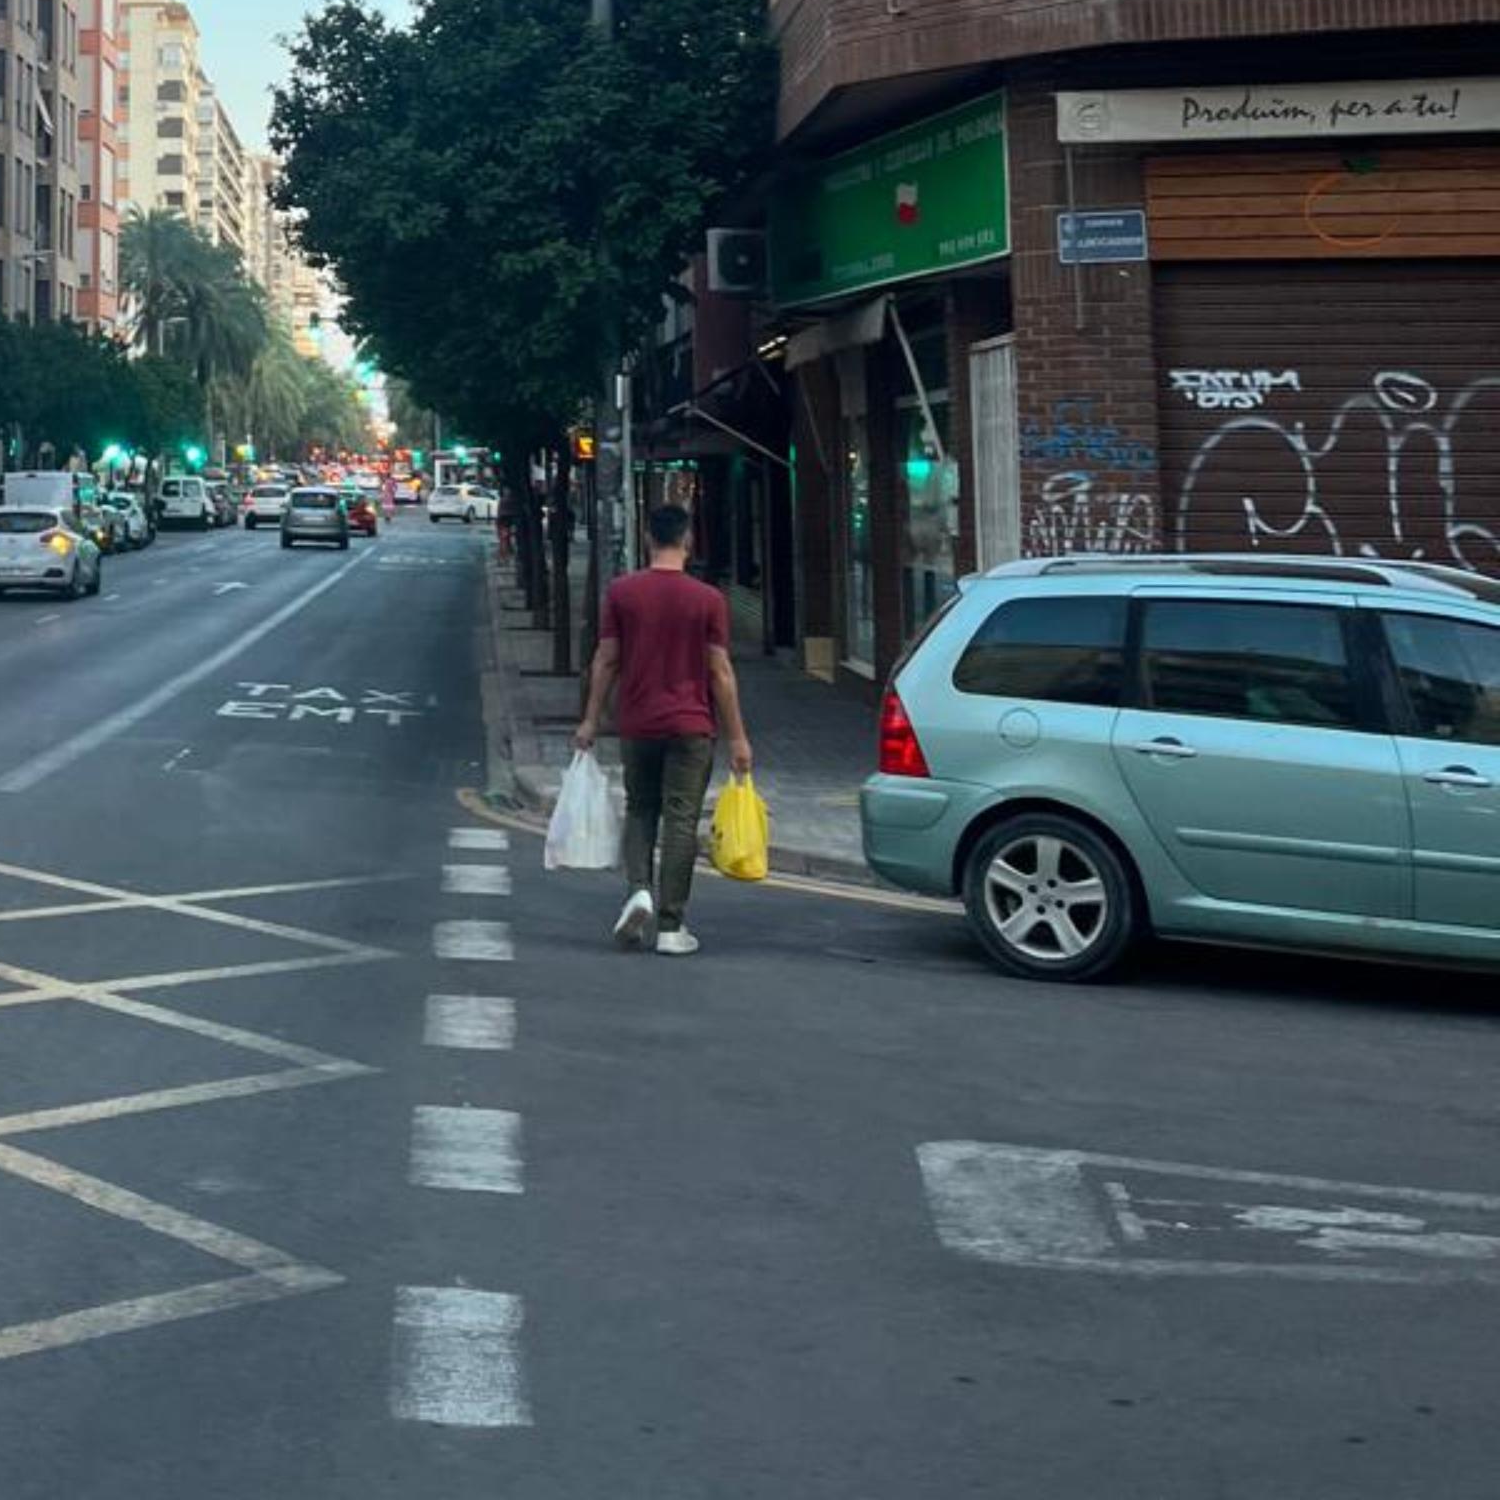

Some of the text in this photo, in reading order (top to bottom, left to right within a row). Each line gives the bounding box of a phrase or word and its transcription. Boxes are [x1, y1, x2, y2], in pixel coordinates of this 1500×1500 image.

[1329, 98, 1376, 128] per
[1383, 99, 1403, 116] a
[1411, 88, 1461, 118] tu!
[215, 700, 422, 726] EMT
